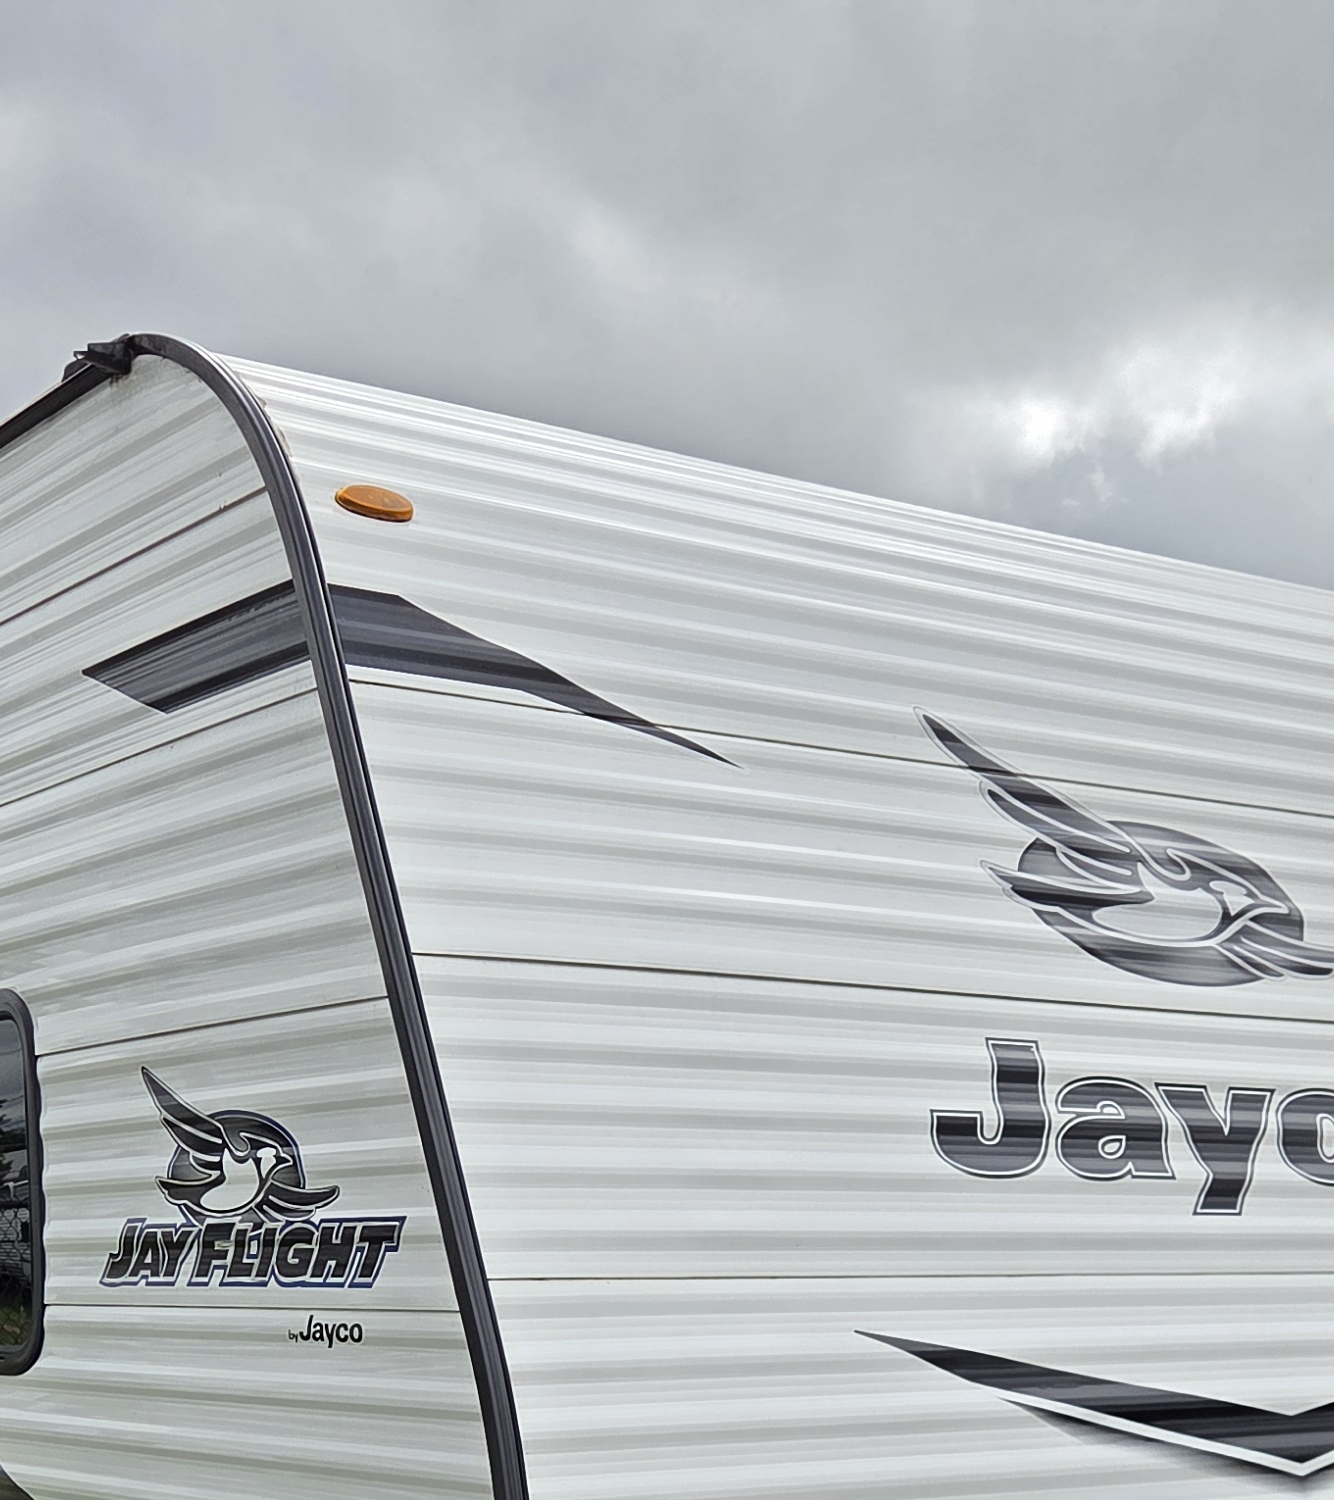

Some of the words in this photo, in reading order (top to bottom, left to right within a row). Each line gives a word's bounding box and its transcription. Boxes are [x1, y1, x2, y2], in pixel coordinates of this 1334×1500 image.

[99, 1218, 196, 1287] JAY
[187, 1215, 407, 1288] FLIGHT
[288, 1329, 299, 1343] by
[298, 1314, 364, 1349] Jayco
